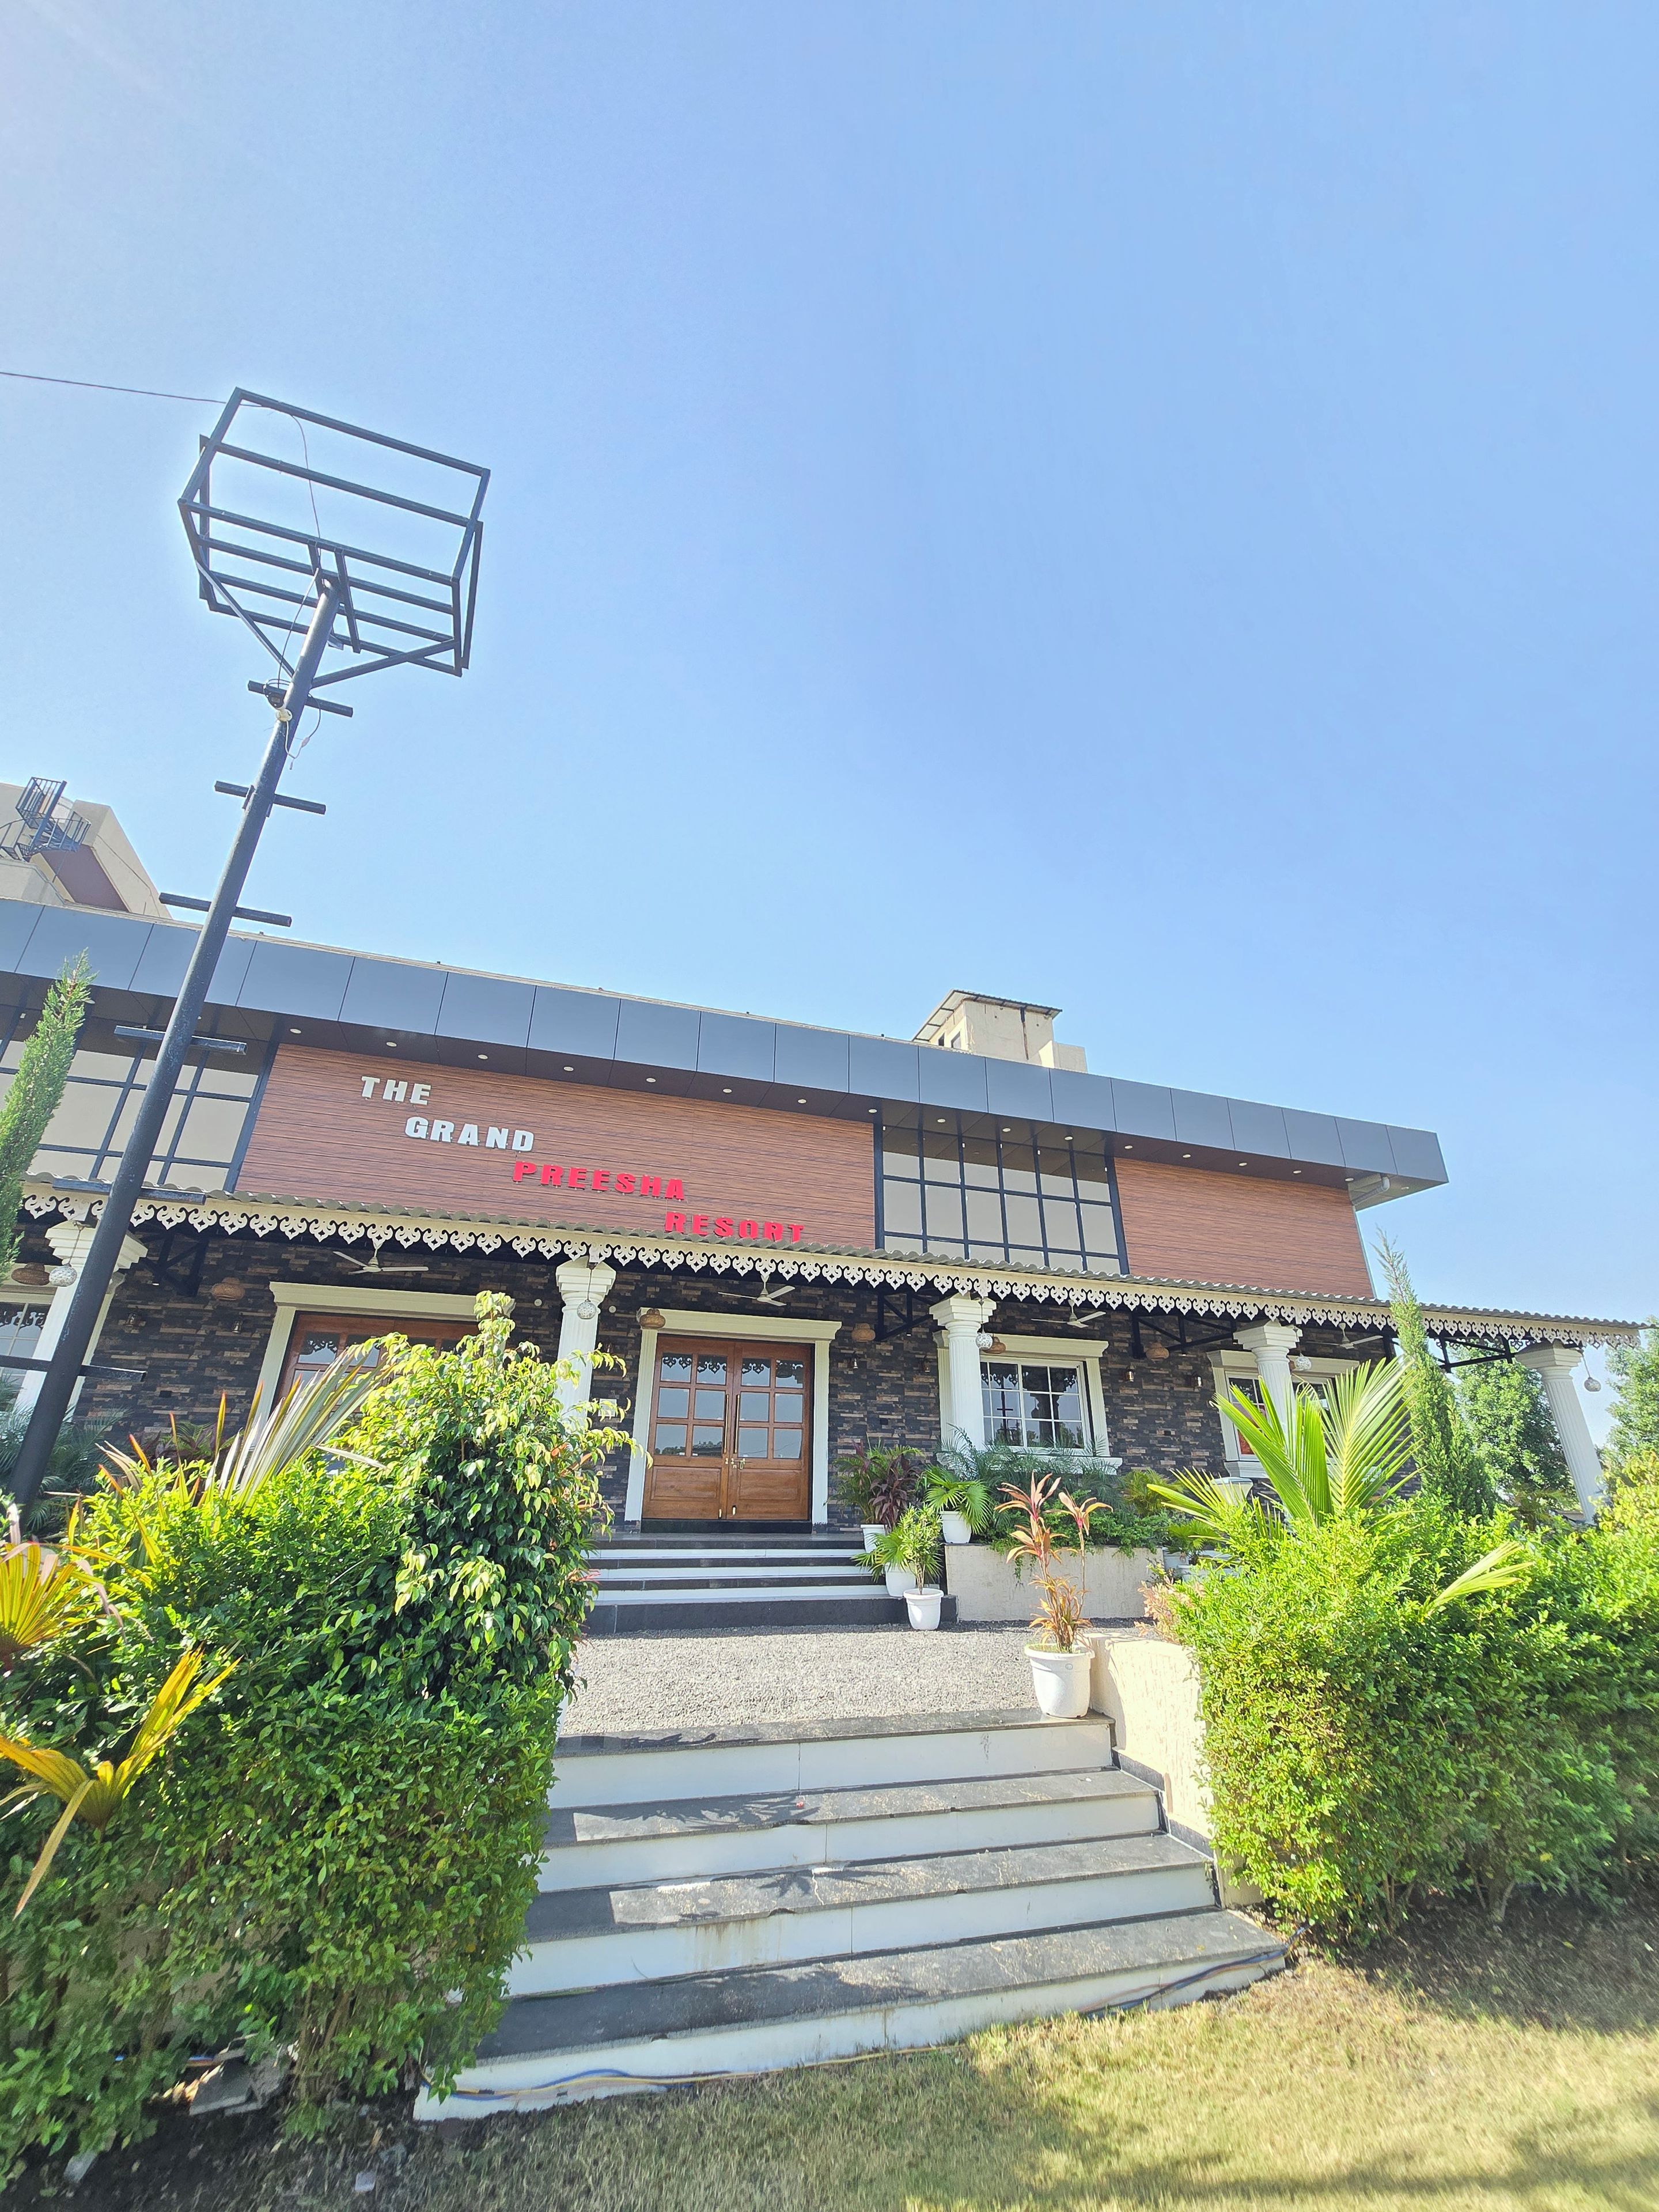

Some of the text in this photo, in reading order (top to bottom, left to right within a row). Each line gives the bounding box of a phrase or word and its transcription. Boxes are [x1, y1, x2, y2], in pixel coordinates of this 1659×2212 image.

[361, 1077, 431, 1104] THE
[405, 1116, 535, 1152] GRAND
[512, 1161, 685, 1200] PREESHA
[665, 1211, 804, 1243] RESORT
